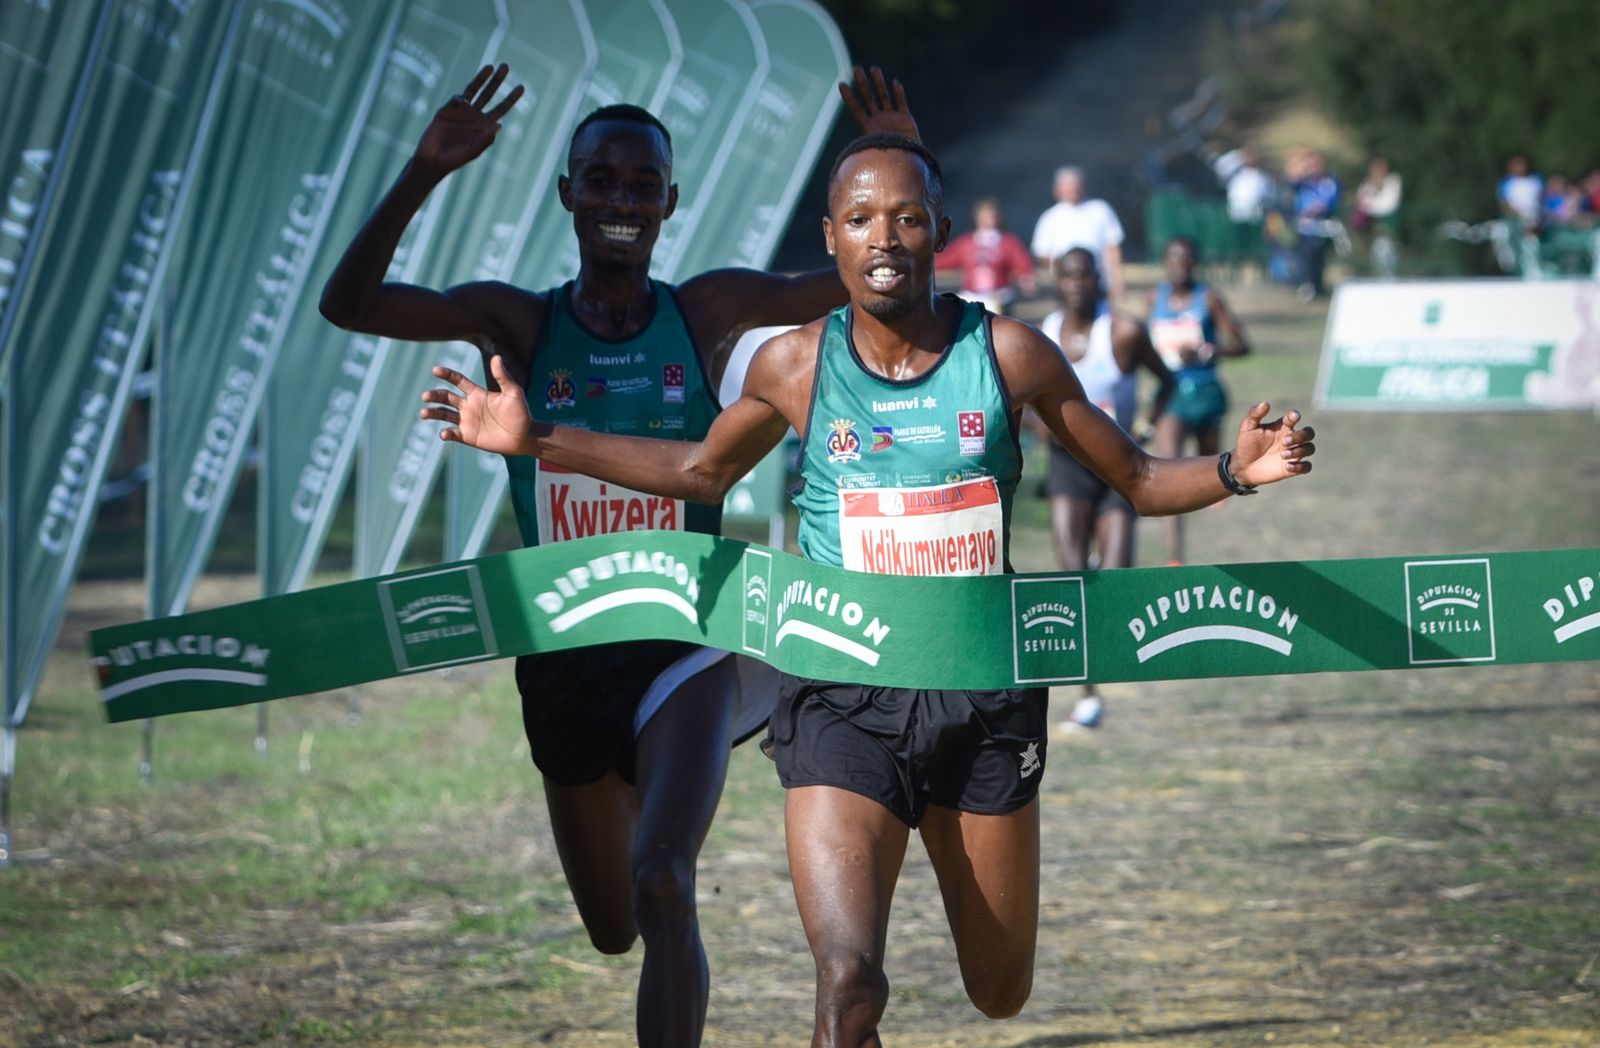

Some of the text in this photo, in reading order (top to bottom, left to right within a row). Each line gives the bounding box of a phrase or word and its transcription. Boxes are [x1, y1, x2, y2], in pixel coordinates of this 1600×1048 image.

[872, 397, 919, 413] luanvi
[182, 365, 256, 513] CROSS
[290, 387, 362, 524] CROSS
[38, 391, 110, 556] CROSS
[551, 483, 676, 542] Kwizera
[862, 529, 996, 575] Ndikumwenayo
[534, 550, 700, 614] DIPUTACION
[1416, 584, 1481, 605] DIPUTACION
[1543, 572, 1600, 622] DIP
[777, 580, 891, 646] DIPUTACION
[1021, 603, 1077, 622] DIPUTACION
[1044, 626, 1054, 634] DE
[1128, 584, 1299, 642] DIPUTACION
[1420, 619, 1481, 634] SEVILLA
[1444, 607, 1455, 616] DE
[90, 635, 271, 668] UTACION
[1024, 638, 1076, 652] SEVILLA
